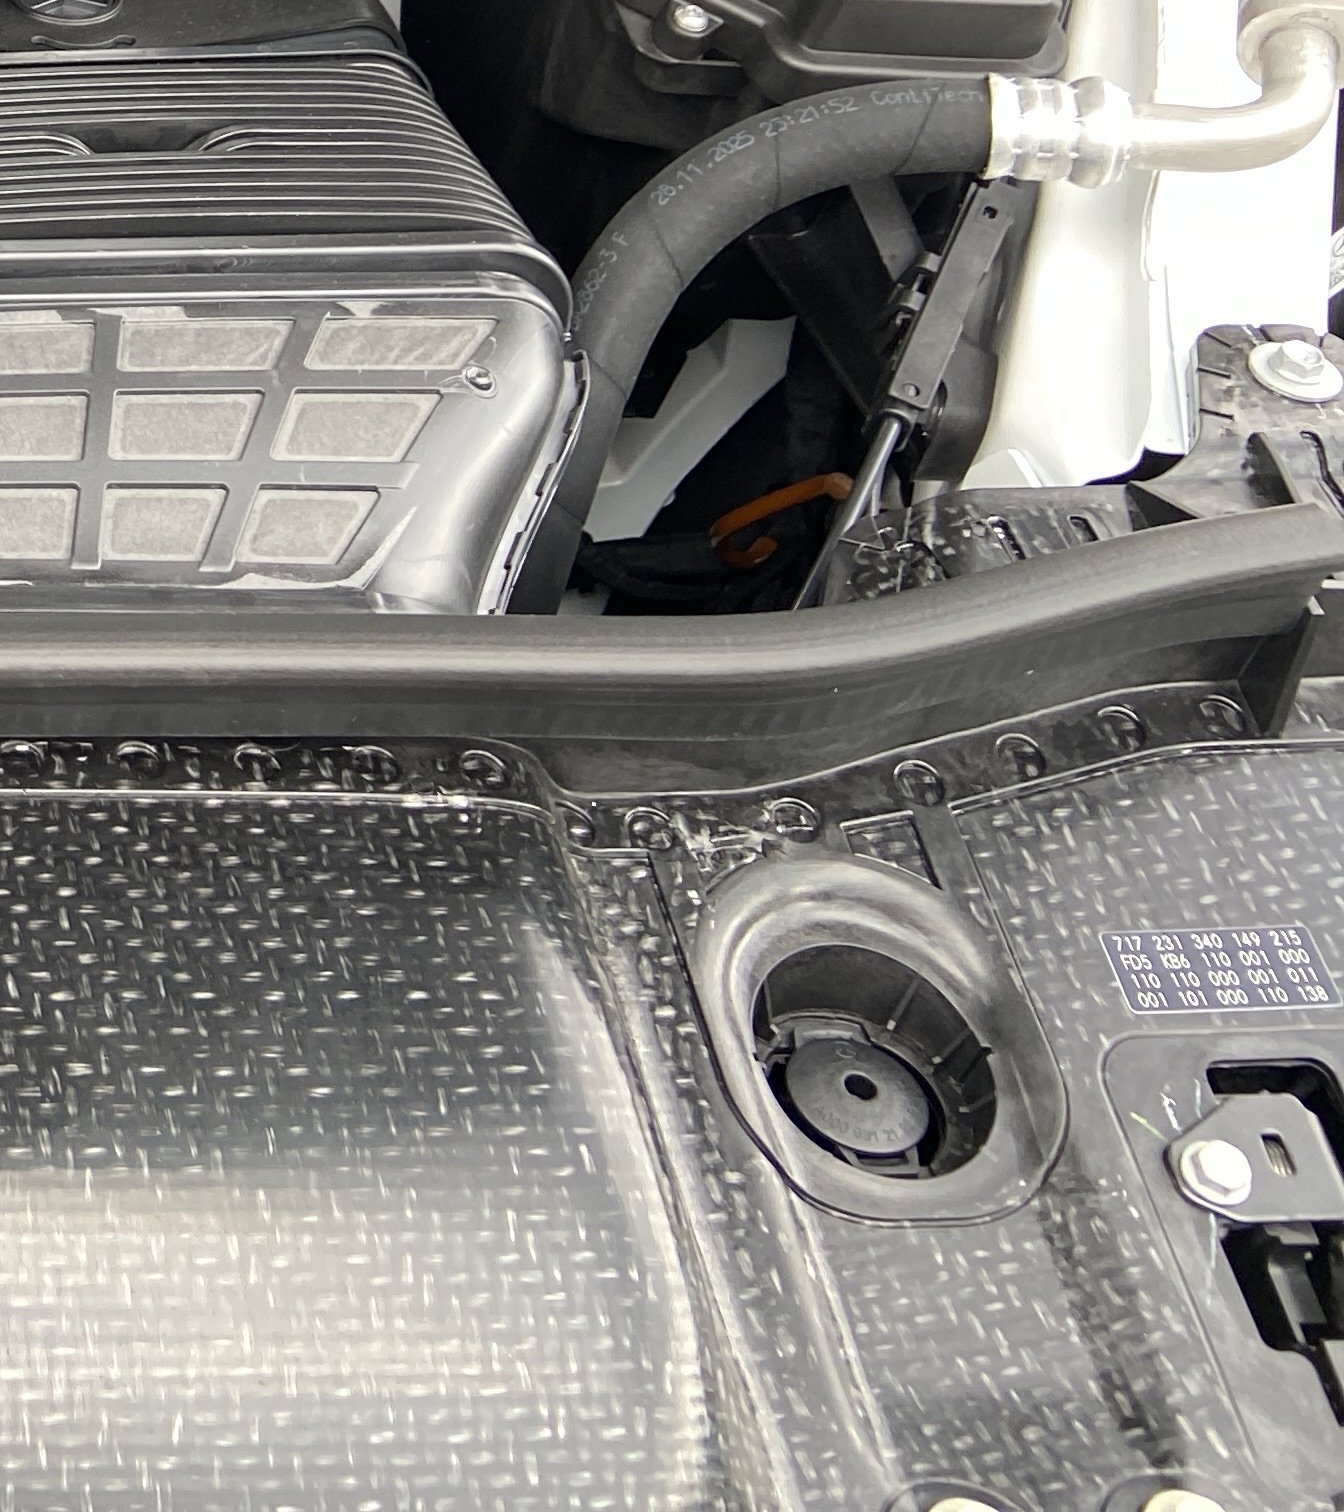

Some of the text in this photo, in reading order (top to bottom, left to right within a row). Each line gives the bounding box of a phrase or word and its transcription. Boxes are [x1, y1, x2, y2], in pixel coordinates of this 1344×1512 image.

[1112, 930, 1302, 951] 717 231 340 149 215
[1120, 948, 1310, 971] FD5 KB6 110 001 000
[1130, 967, 1318, 989] 110 110 000 001 011
[1137, 992, 1168, 1008] 001
[1178, 991, 1208, 1006] 101
[1216, 989, 1249, 1005] 000
[1257, 988, 1289, 1003] 110
